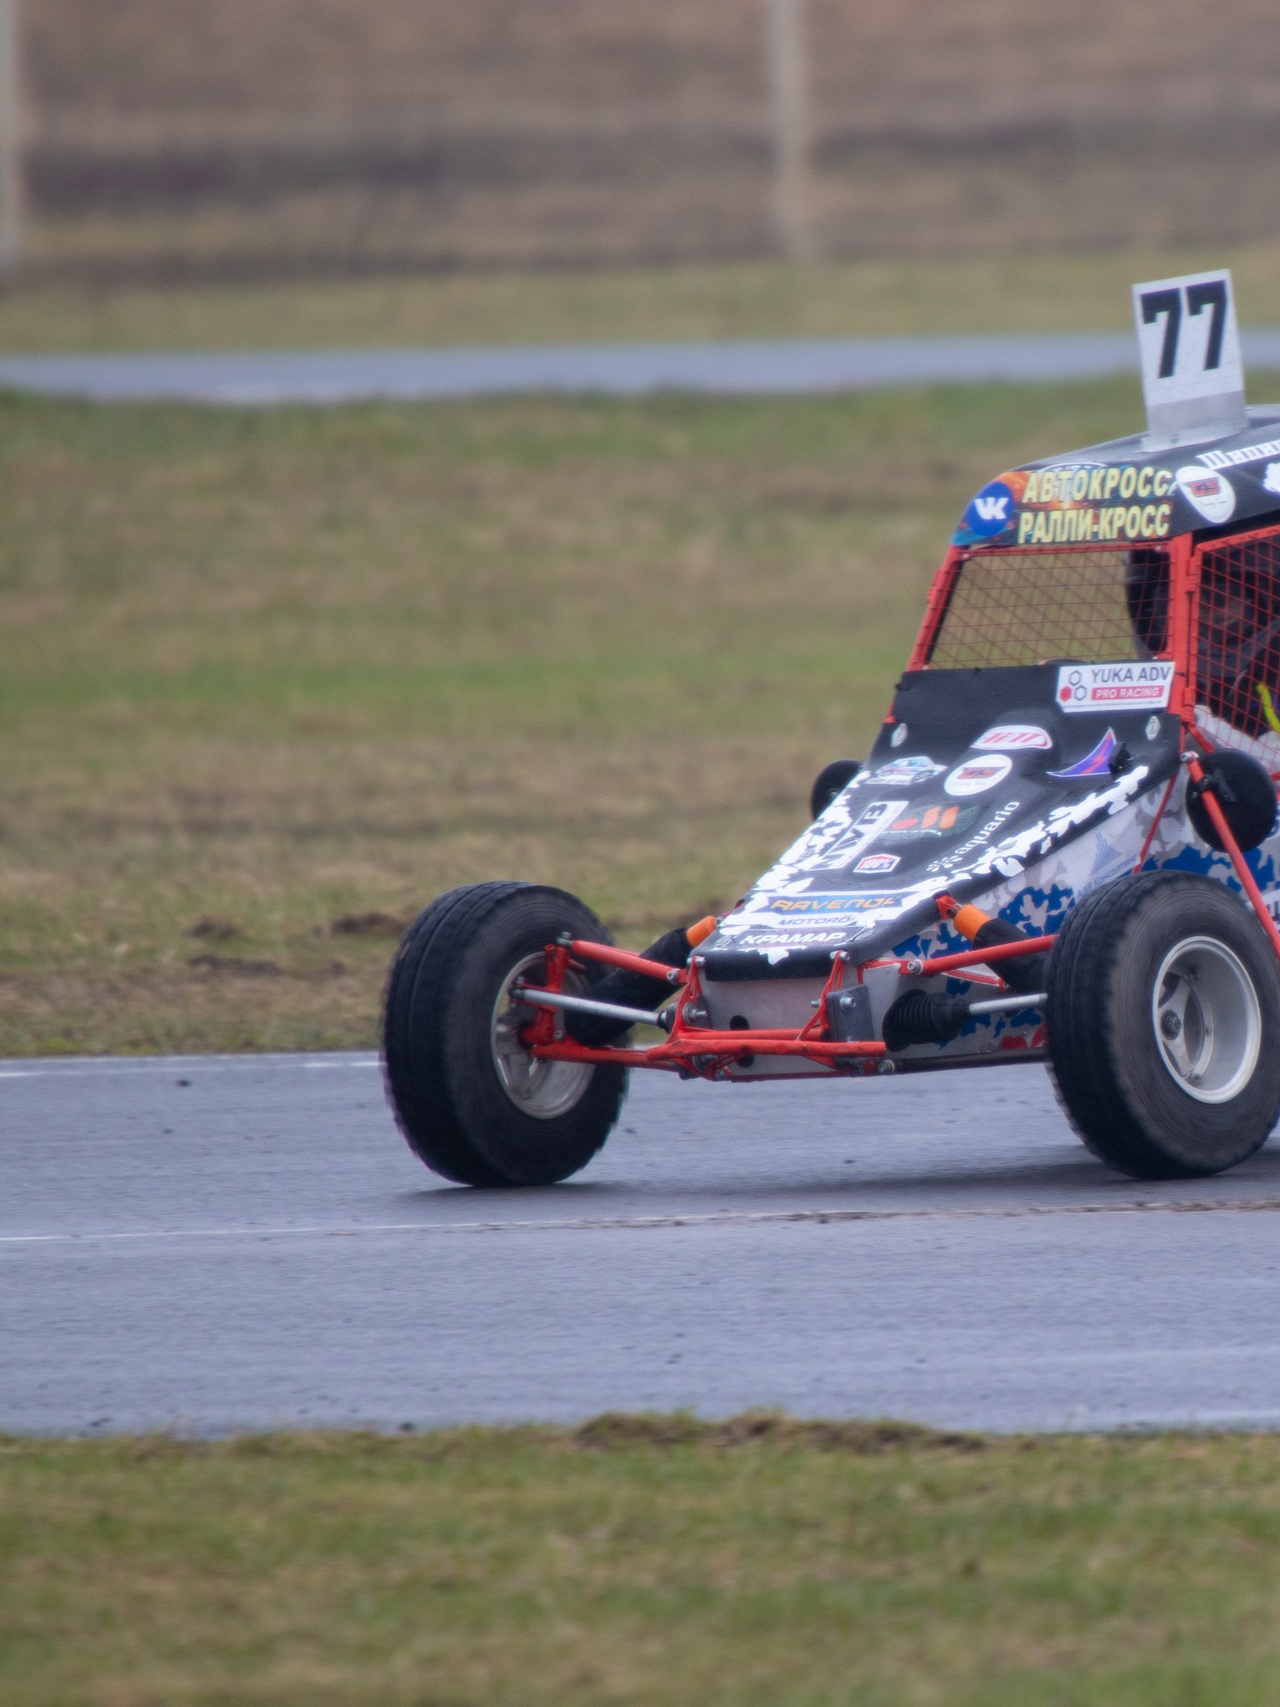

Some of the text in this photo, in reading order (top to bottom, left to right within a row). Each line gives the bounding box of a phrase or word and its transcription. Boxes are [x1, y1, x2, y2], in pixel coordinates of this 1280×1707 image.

[1140, 280, 1227, 378] 77
[1022, 467, 1173, 503] АВТОКРОСС
[1018, 504, 1171, 544] РАЛЛИ-КРОСС
[1091, 666, 1171, 683] YUKA ADV
[1095, 687, 1160, 698] PRO RACING
[954, 801, 1020, 856] aquario
[778, 915, 855, 926] MOTORÖ
